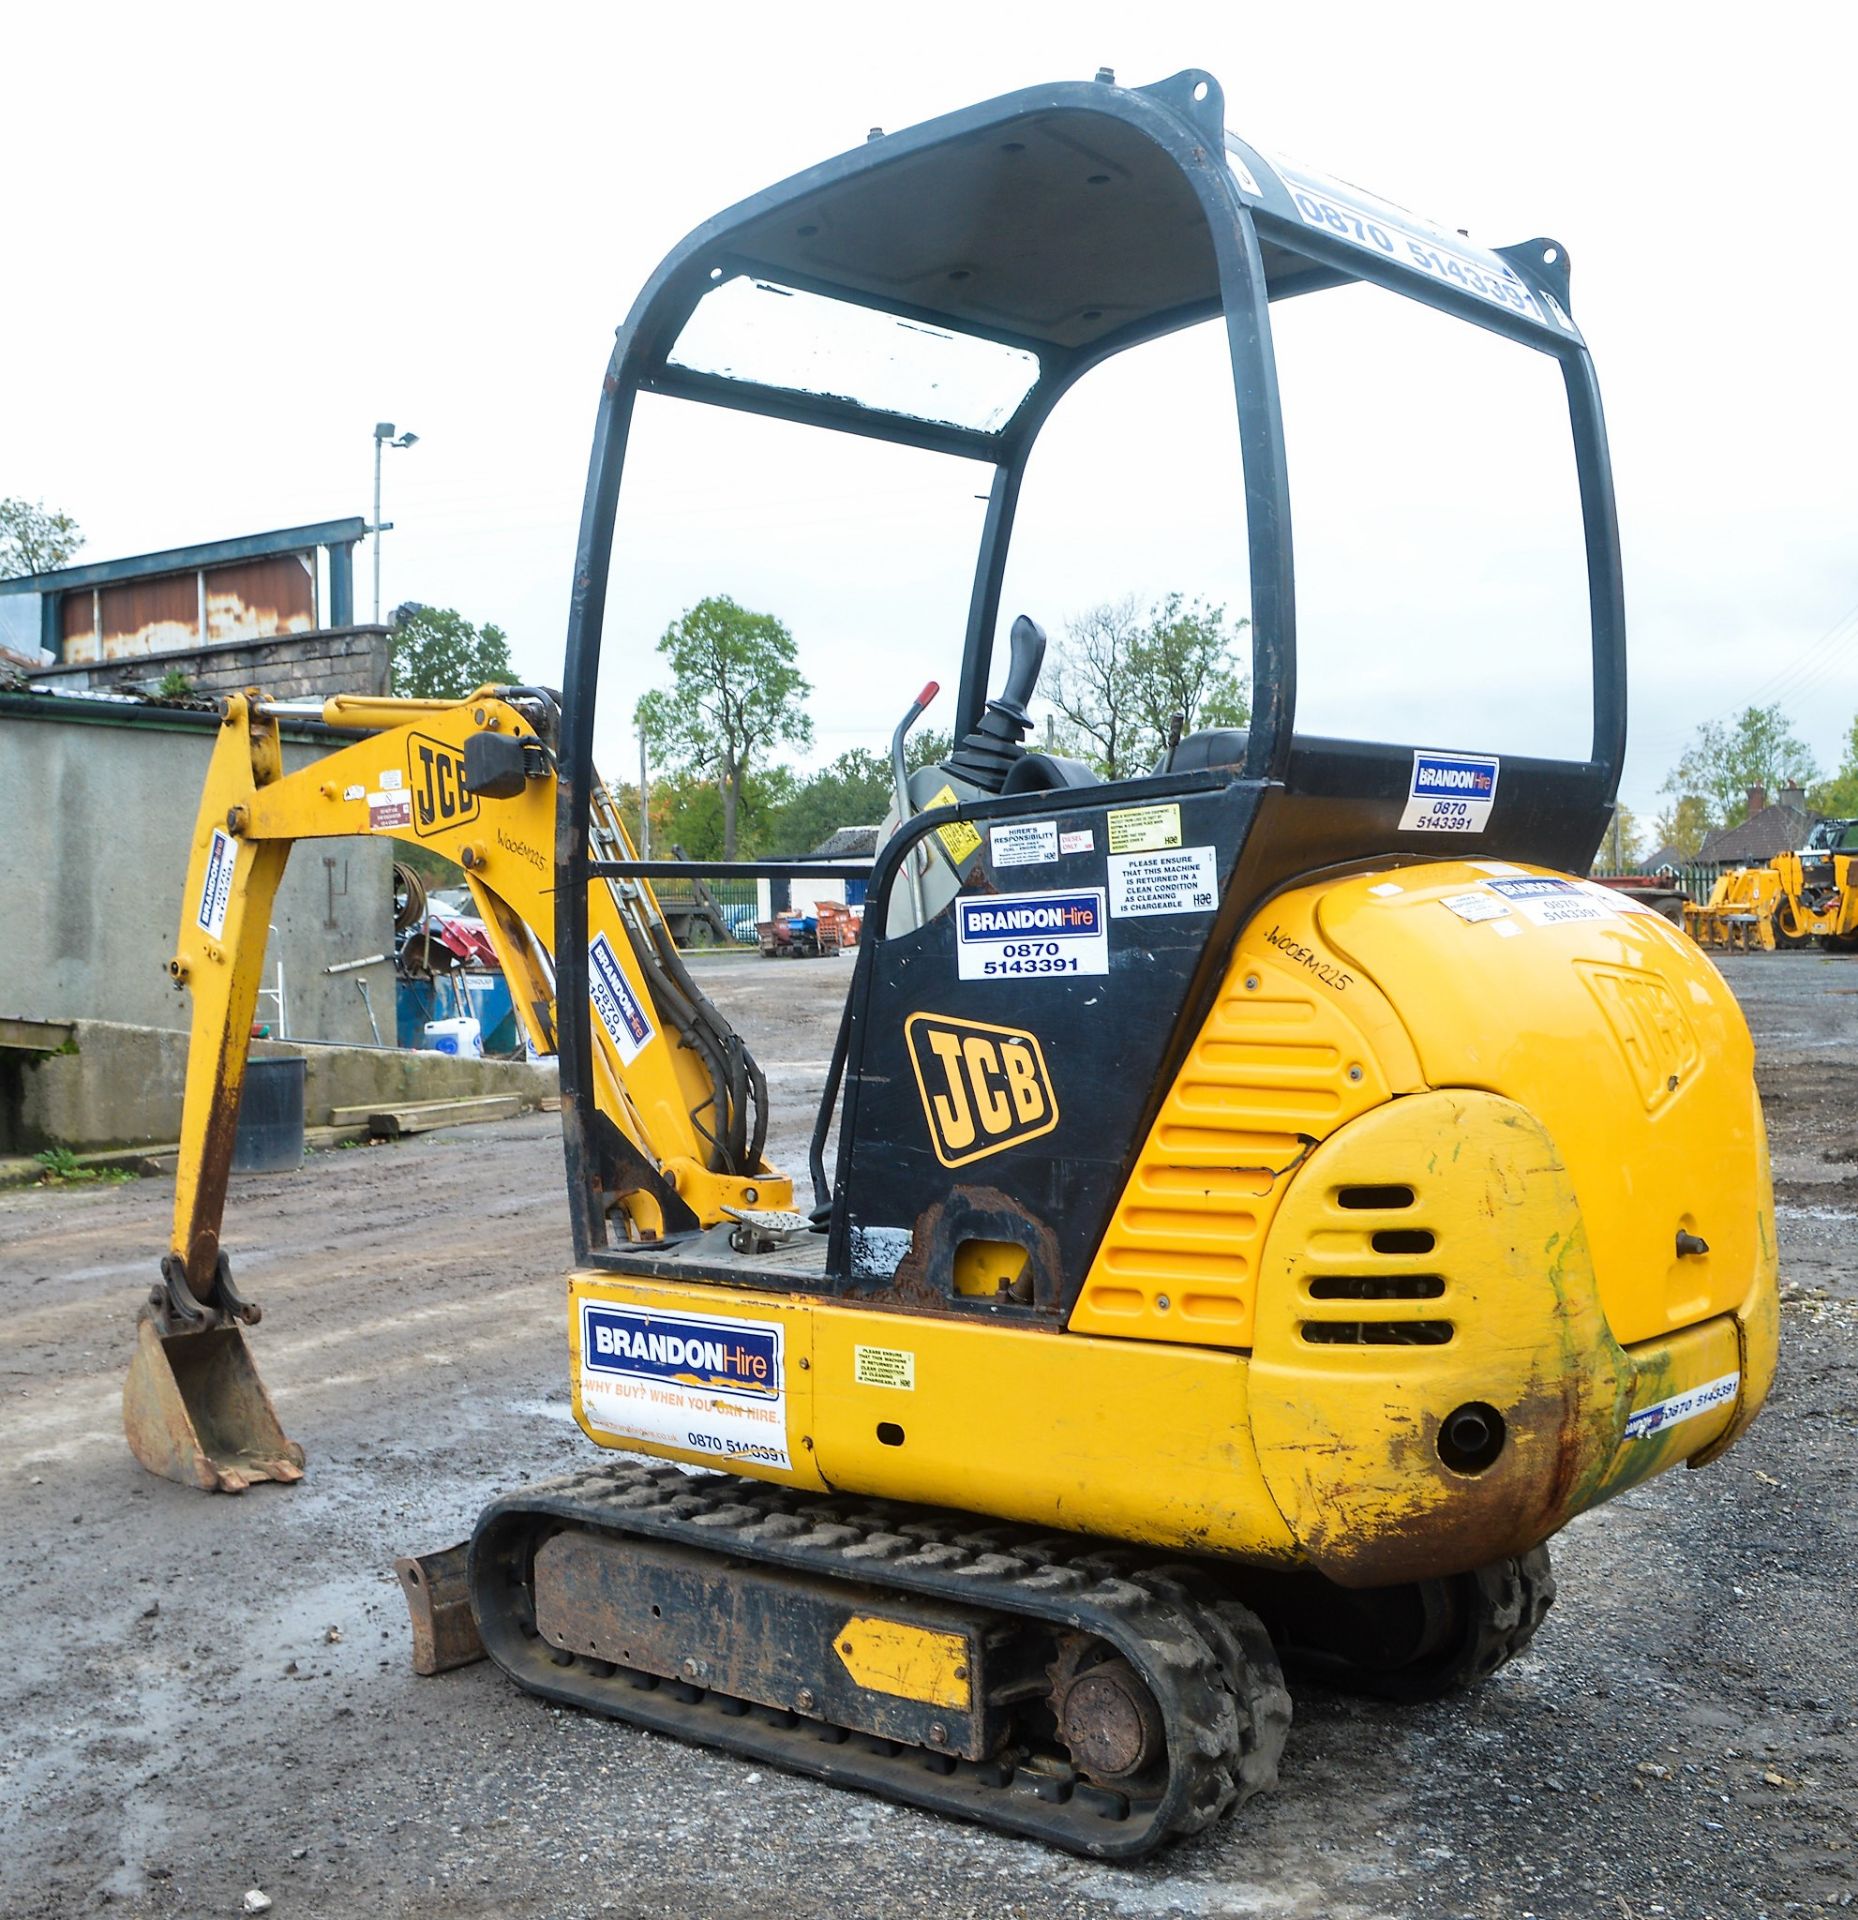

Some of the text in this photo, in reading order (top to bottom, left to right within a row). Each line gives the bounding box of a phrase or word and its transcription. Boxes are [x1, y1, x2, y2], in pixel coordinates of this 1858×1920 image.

[1295, 193, 1541, 317] 0870 5143391
[1433, 801, 1467, 815] 0870
[1417, 817, 1472, 829] 5143391
[994, 832, 1053, 843] RESPONSIBILITY
[1129, 856, 1192, 868] PLEASE ENSURE
[1122, 869, 1141, 877] THAT
[1164, 864, 1200, 873] MACHINE
[1136, 875, 1178, 884] RETURNED
[1126, 882, 1198, 895] CLEAN CONDITION
[1137, 892, 1176, 902] CLEANING
[1130, 901, 1182, 911] CHARGEABLE
[1543, 900, 1579, 910] 0870
[1543, 909, 1600, 922] 5143391
[1003, 942, 1059, 958] 0870
[984, 958, 1078, 975] 5143391
[597, 983, 620, 1025] 0870
[589, 978, 621, 1044] 143391
[927, 1029, 1045, 1149] JCB
[584, 1380, 610, 1394] WHY
[615, 1383, 646, 1399] BUY?
[650, 1390, 684, 1407] WHEN
[687, 1398, 717, 1413] YOU
[746, 1407, 781, 1424] HIRE.
[688, 1432, 722, 1450] 0870
